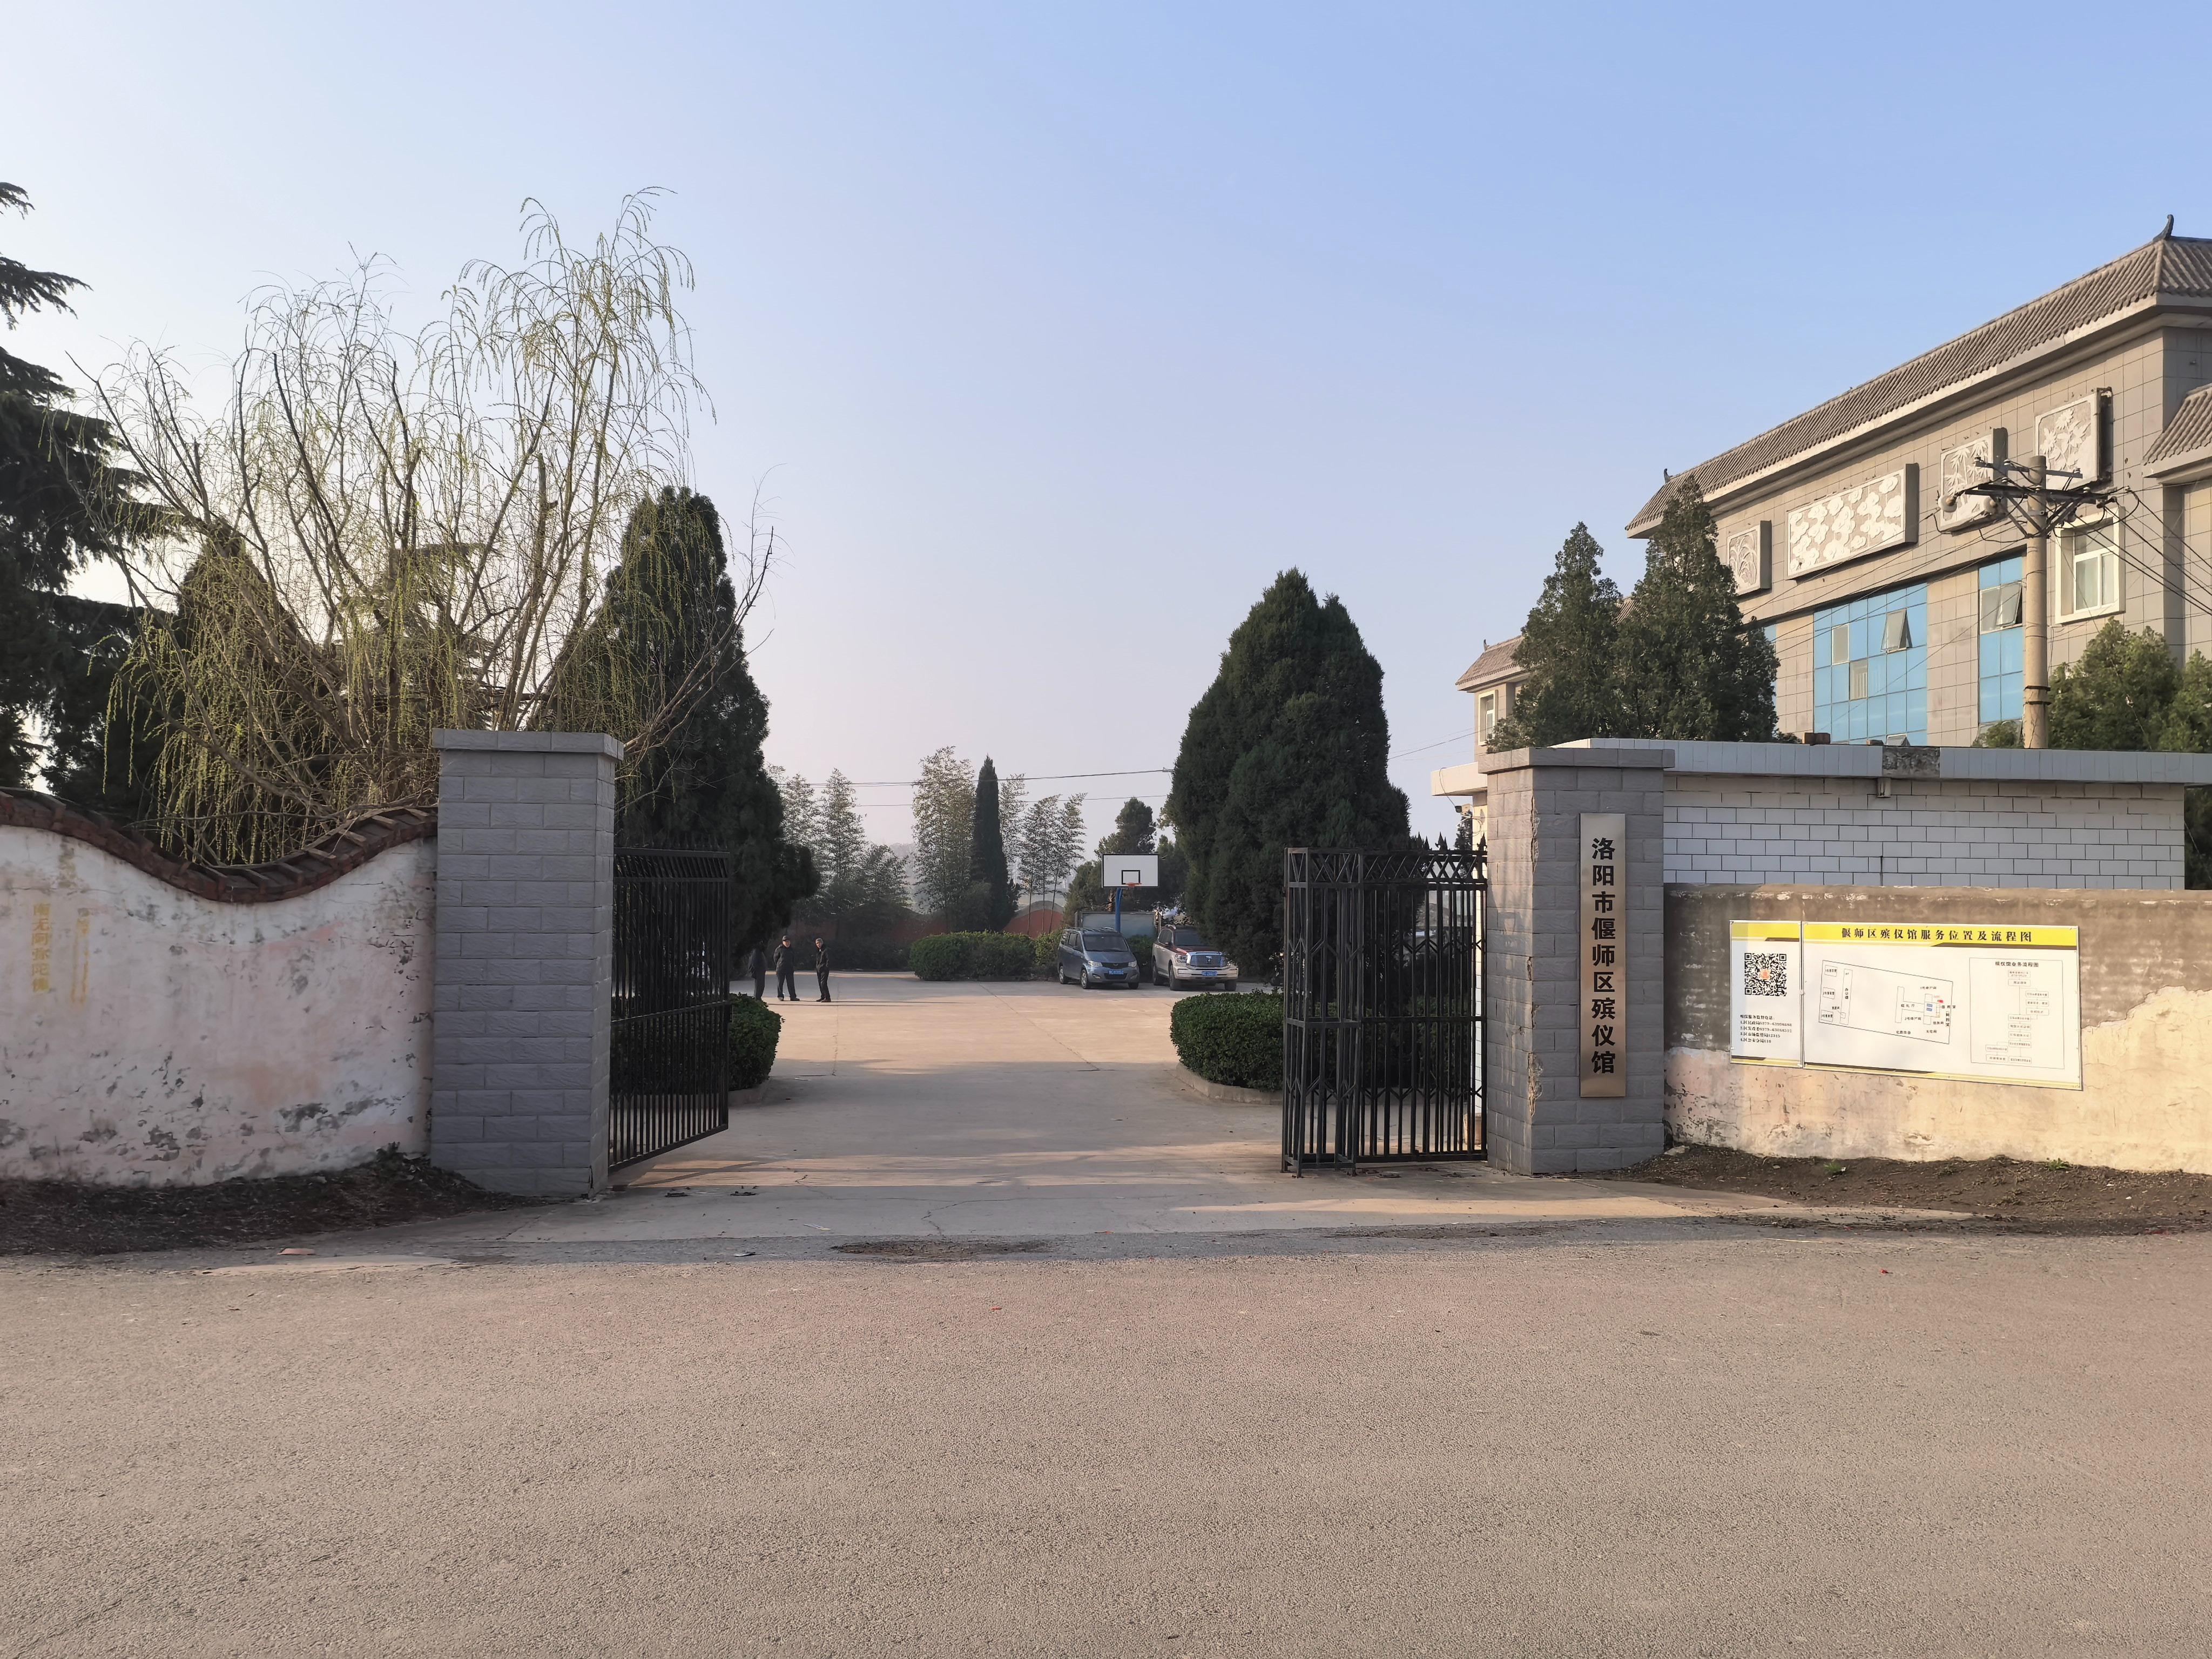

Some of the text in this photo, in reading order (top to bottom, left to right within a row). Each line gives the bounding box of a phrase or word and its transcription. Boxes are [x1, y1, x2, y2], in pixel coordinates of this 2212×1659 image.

[1591, 838, 1615, 1074] 洛阳市偃师区殡仪馆
[1842, 928, 2032, 942] 偃师区殡仪馆服务位置及流程图
